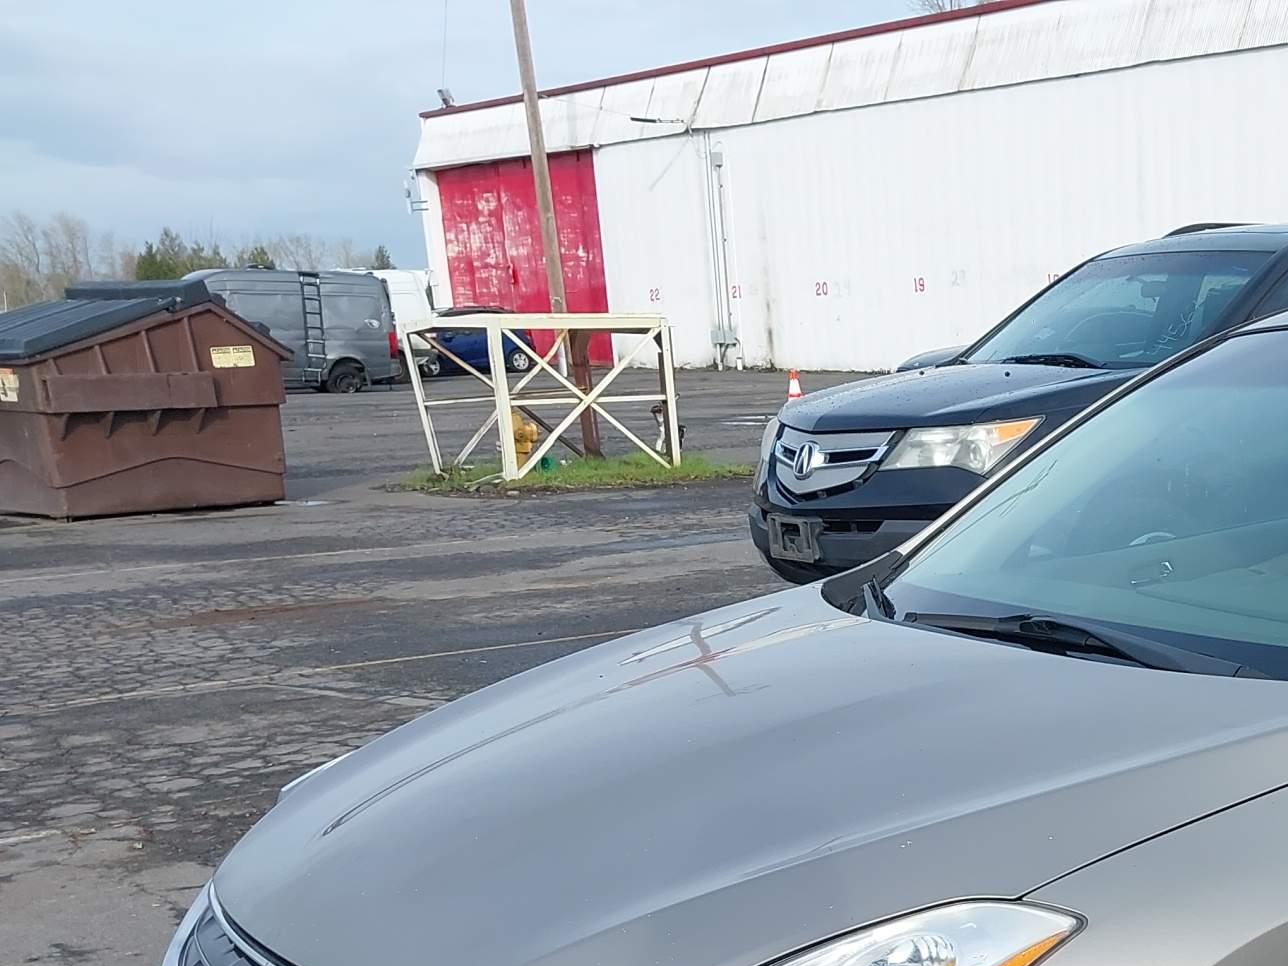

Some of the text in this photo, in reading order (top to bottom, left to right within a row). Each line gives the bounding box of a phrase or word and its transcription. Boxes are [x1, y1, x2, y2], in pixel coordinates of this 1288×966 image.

[731, 285, 742, 299] 21
[815, 281, 828, 296] 20
[913, 277, 926, 293] 19
[649, 288, 660, 302] 22
